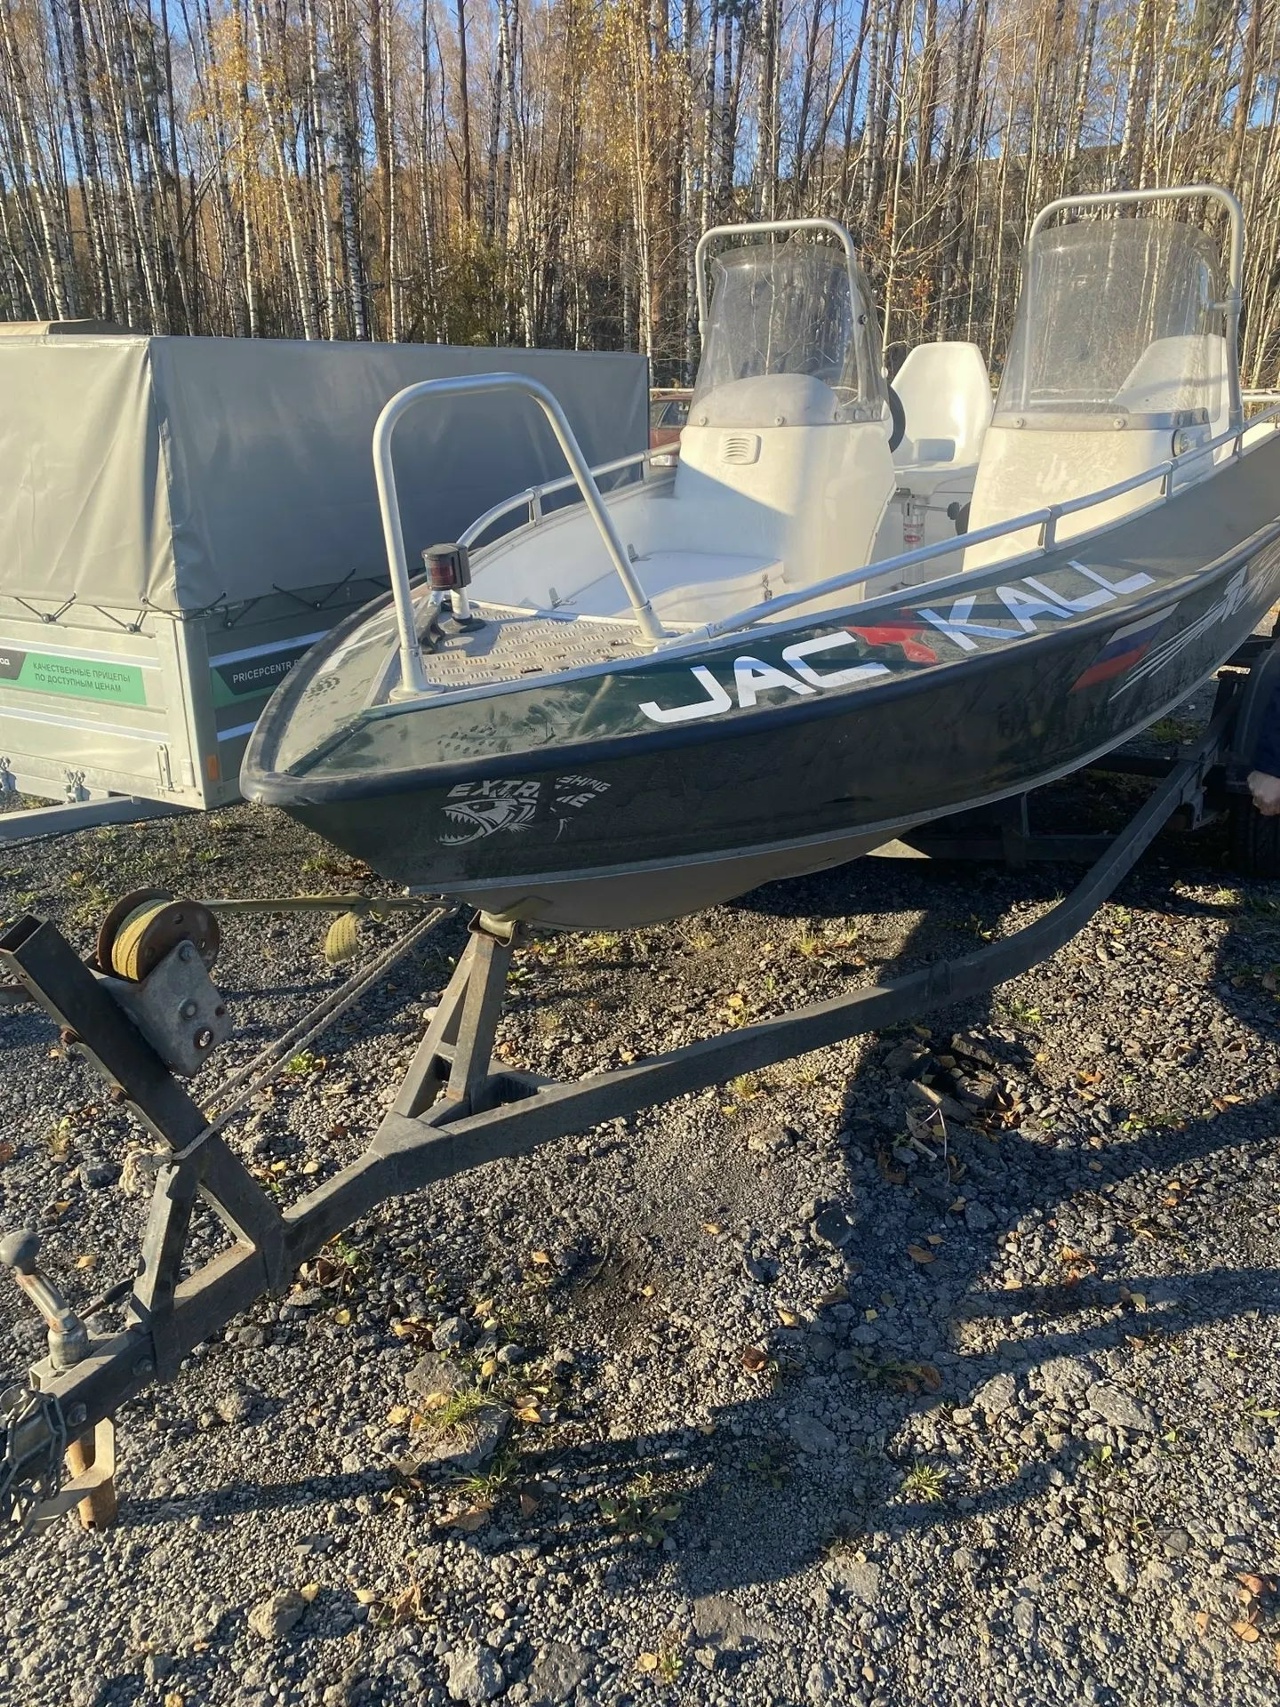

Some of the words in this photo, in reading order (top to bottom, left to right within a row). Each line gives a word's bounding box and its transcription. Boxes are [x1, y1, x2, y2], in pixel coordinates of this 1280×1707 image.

[32, 661, 92, 678] КАЧЕСТВЕННЫЕ
[92, 669, 131, 683] ПРИЦЕПЫ
[34, 672, 46, 682] ПО
[47, 674, 94, 688] ДОСТУПНЫМ
[94, 682, 122, 693] ЦЕНАМ
